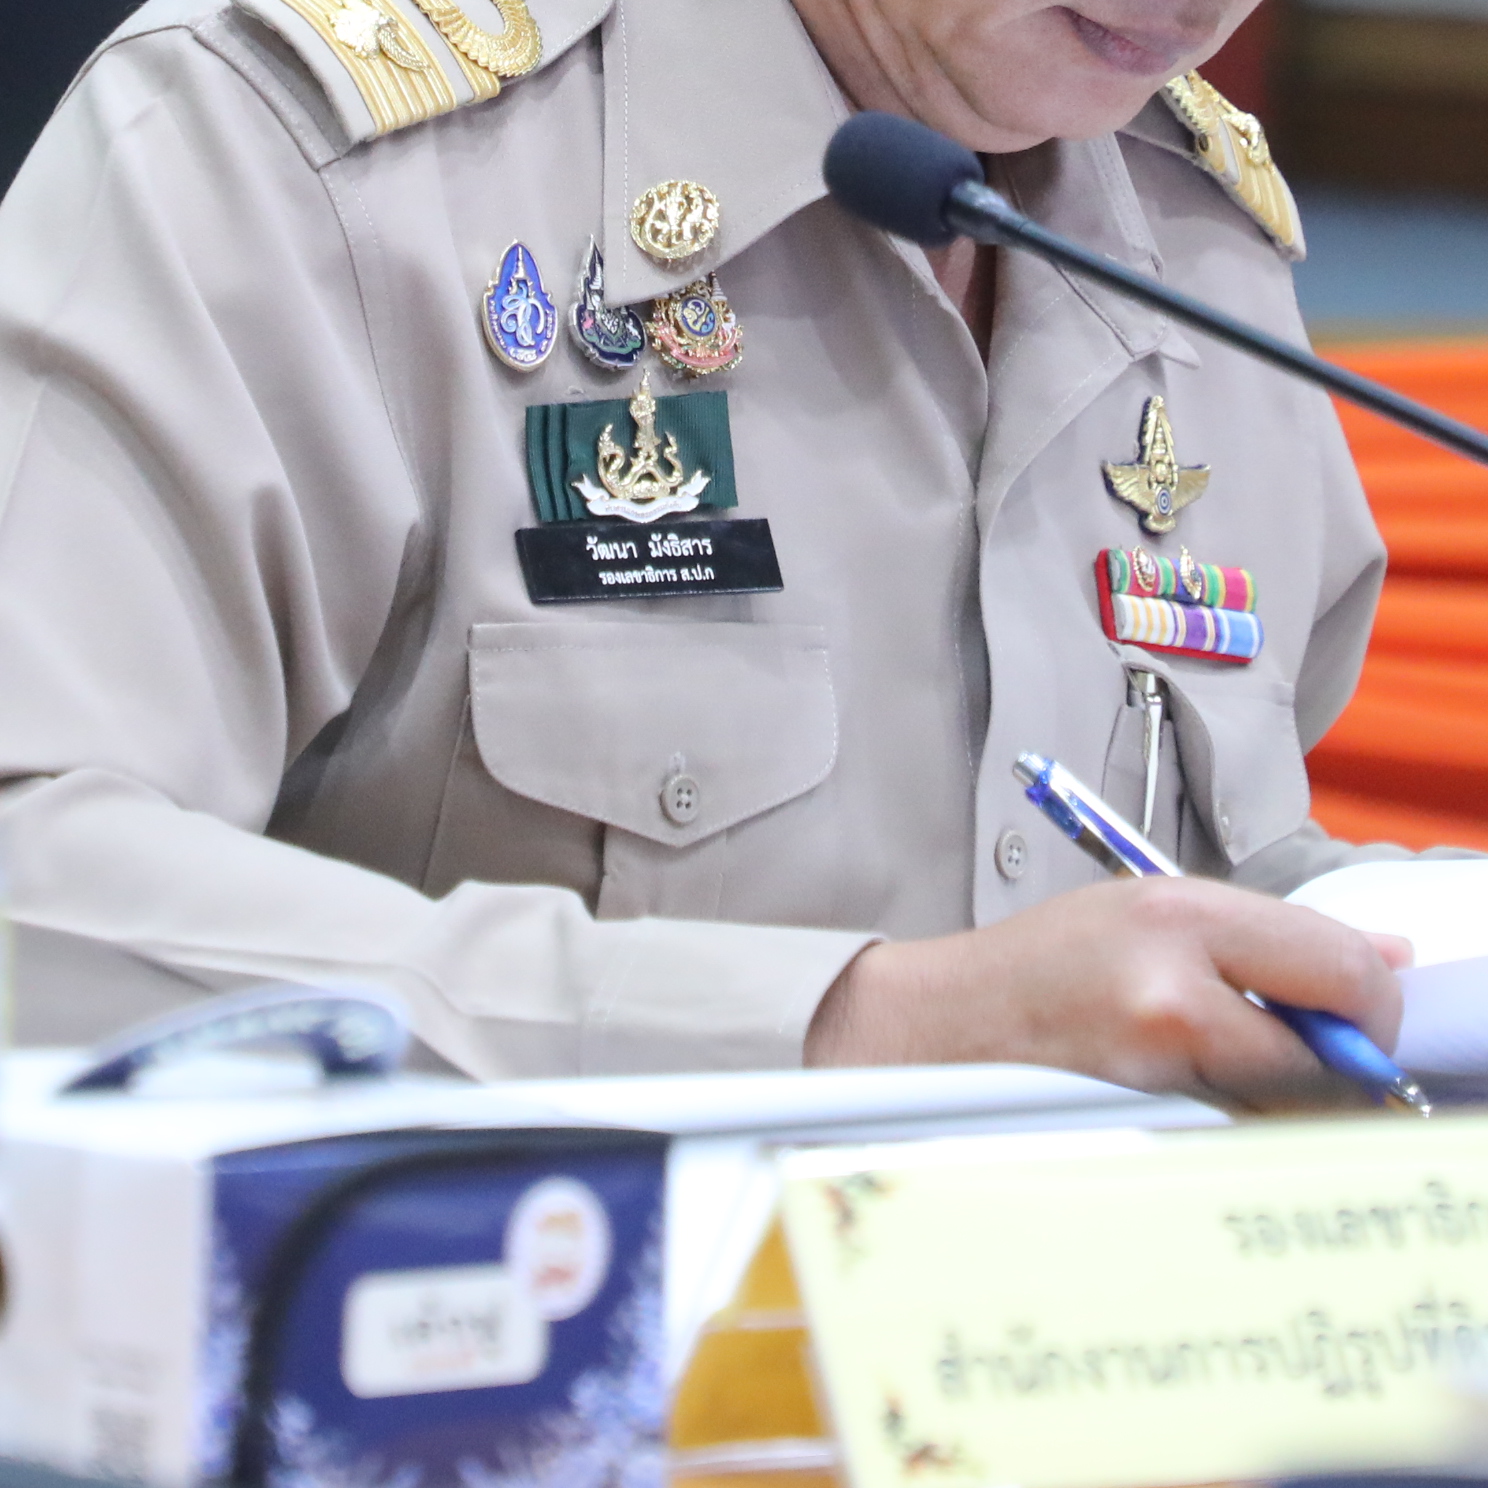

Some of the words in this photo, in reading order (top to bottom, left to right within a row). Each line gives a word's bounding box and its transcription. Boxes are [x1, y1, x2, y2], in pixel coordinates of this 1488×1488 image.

[585, 535, 638, 560] วัฒนา
[647, 532, 714, 558] มังธิสาร
[598, 565, 678, 586] รองเลขาธิการ
